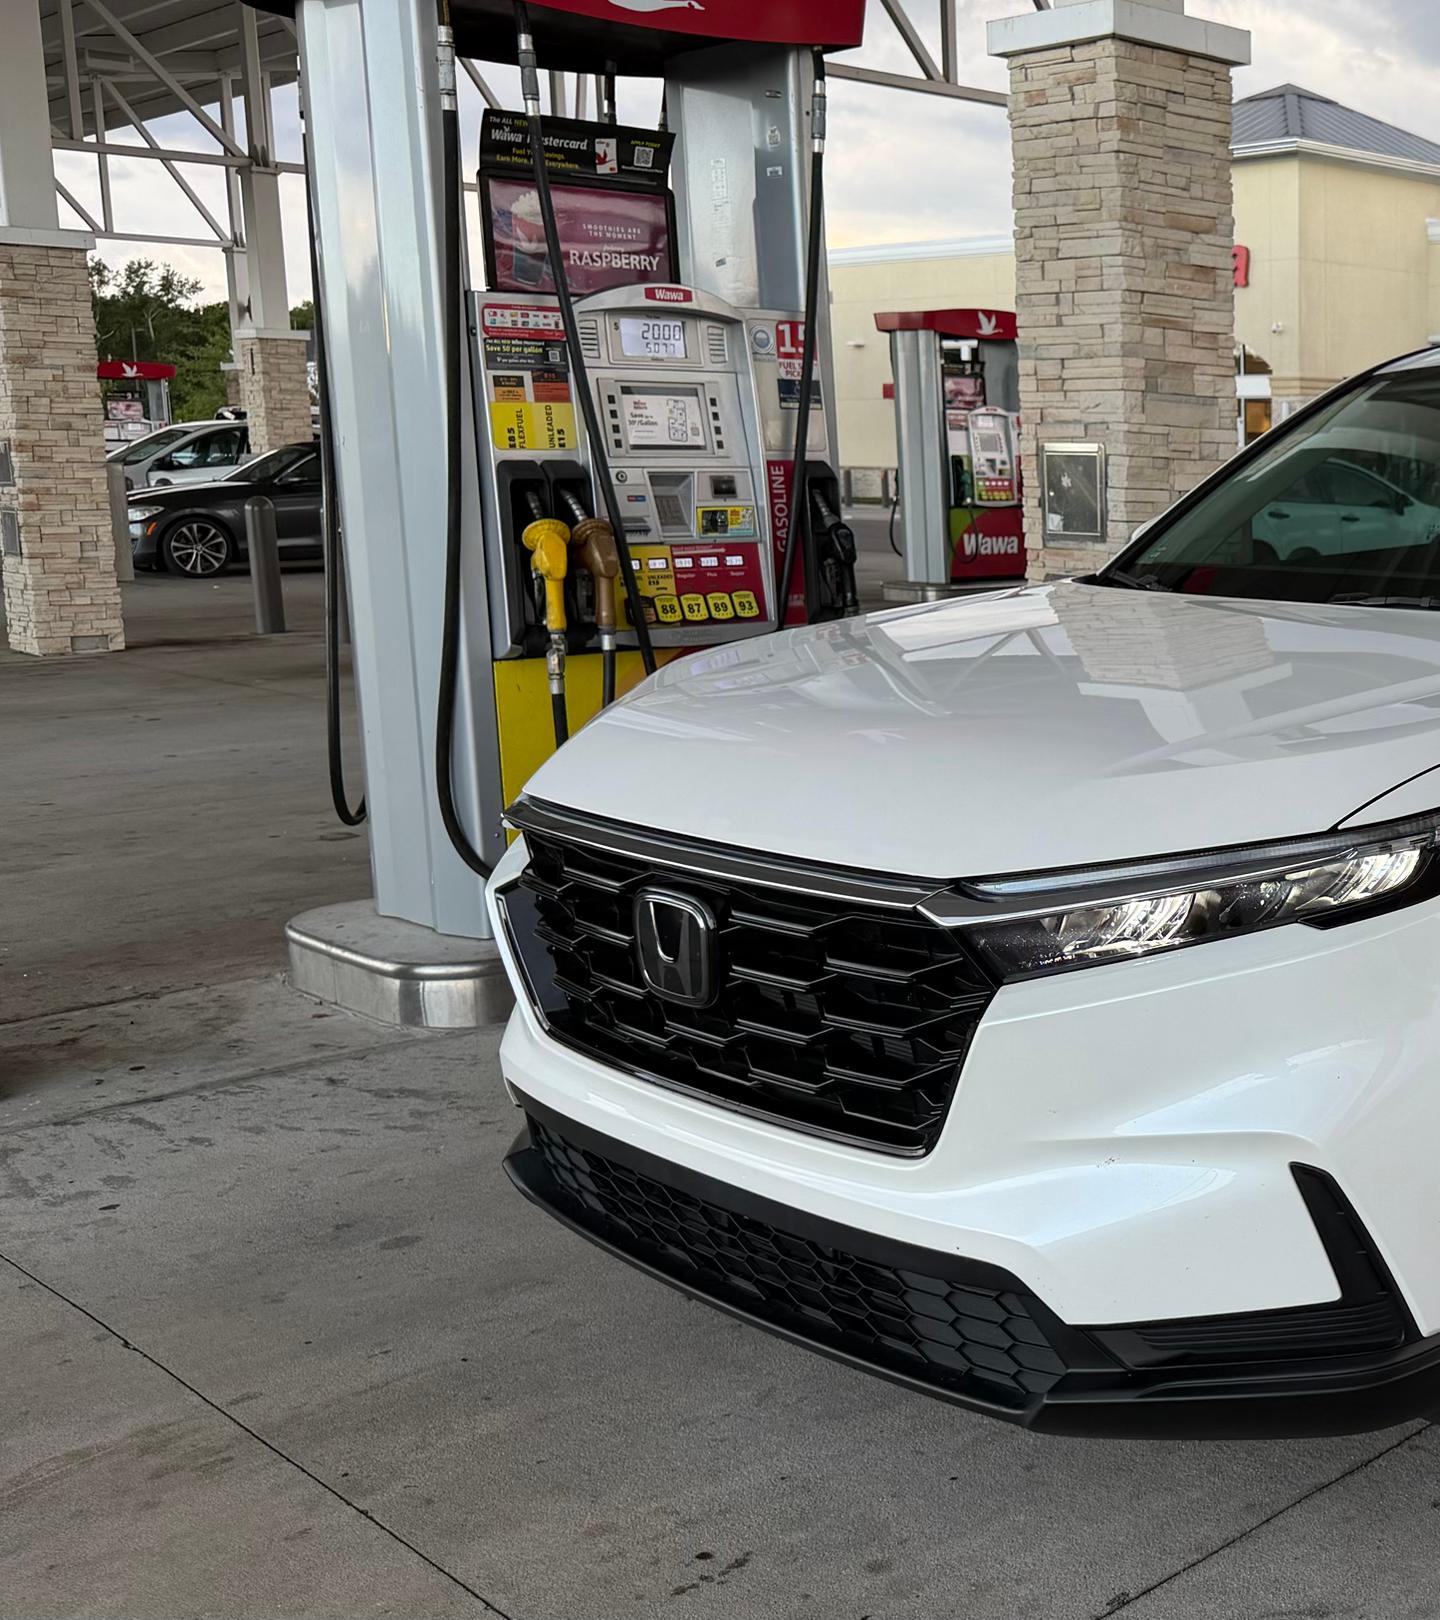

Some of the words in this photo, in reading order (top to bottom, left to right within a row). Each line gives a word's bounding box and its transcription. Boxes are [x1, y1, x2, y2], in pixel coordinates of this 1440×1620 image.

[490, 116, 501, 124] The
[501, 117, 512, 125] ALL
[491, 128, 523, 144] Wawa
[583, 223, 625, 234] SMOOTHIES
[628, 227, 641, 235] ARE
[606, 231, 637, 240] MOMENT
[569, 249, 660, 271] RASPBERRY
[655, 288, 684, 301] Wawa
[523, 346, 543, 354] gallon
[779, 361, 798, 370] FUEL
[516, 408, 526, 449] FLEXFUEL
[545, 404, 556, 448] UNLEADED
[507, 427, 516, 448] E85
[557, 428, 566, 448] E15
[770, 465, 789, 553] GASOLINE
[963, 533, 1019, 556] Wawa
[661, 604, 677, 614] 88
[687, 603, 702, 614] 87
[713, 601, 728, 613] 89
[739, 600, 754, 611] 93
